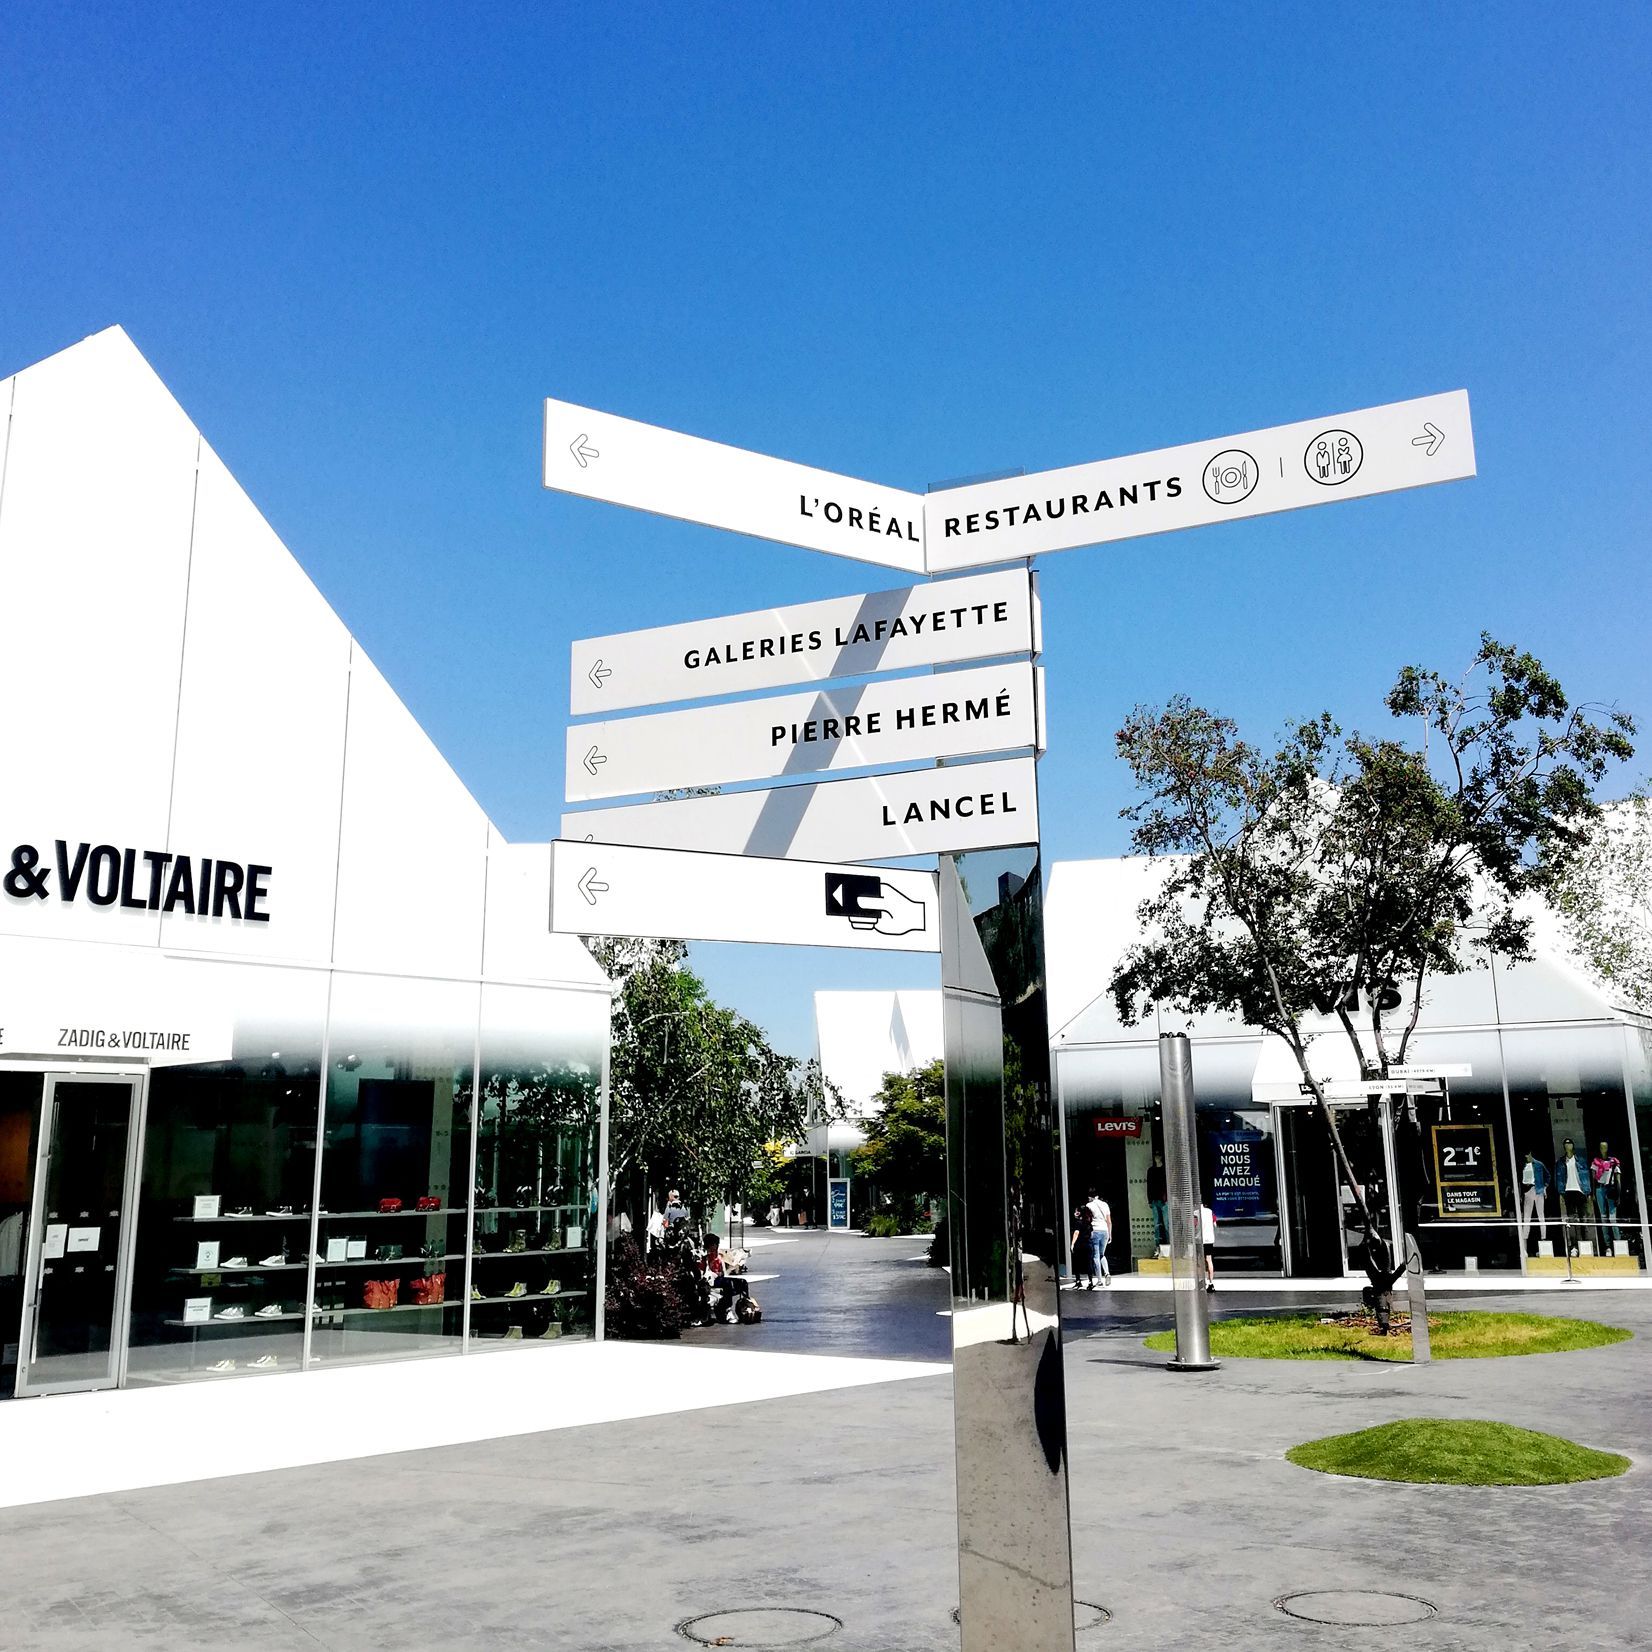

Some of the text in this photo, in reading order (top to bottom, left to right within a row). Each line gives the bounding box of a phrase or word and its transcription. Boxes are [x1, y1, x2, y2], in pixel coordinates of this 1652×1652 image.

[944, 476, 1182, 538] RESTAURANTS
[684, 601, 1008, 669] GALERIES LAFAYETTE
[771, 687, 1011, 747] PIERRE HERMÉ
[882, 791, 1017, 826] LANCEL
[1219, 1143, 1250, 1153] VOUS
[1442, 1147, 1457, 1166] 2
[1220, 1155, 1251, 1165] NOUS
[1222, 1166, 1251, 1175] AVEZ
[1214, 1174, 1261, 1187] MANQUÉ
